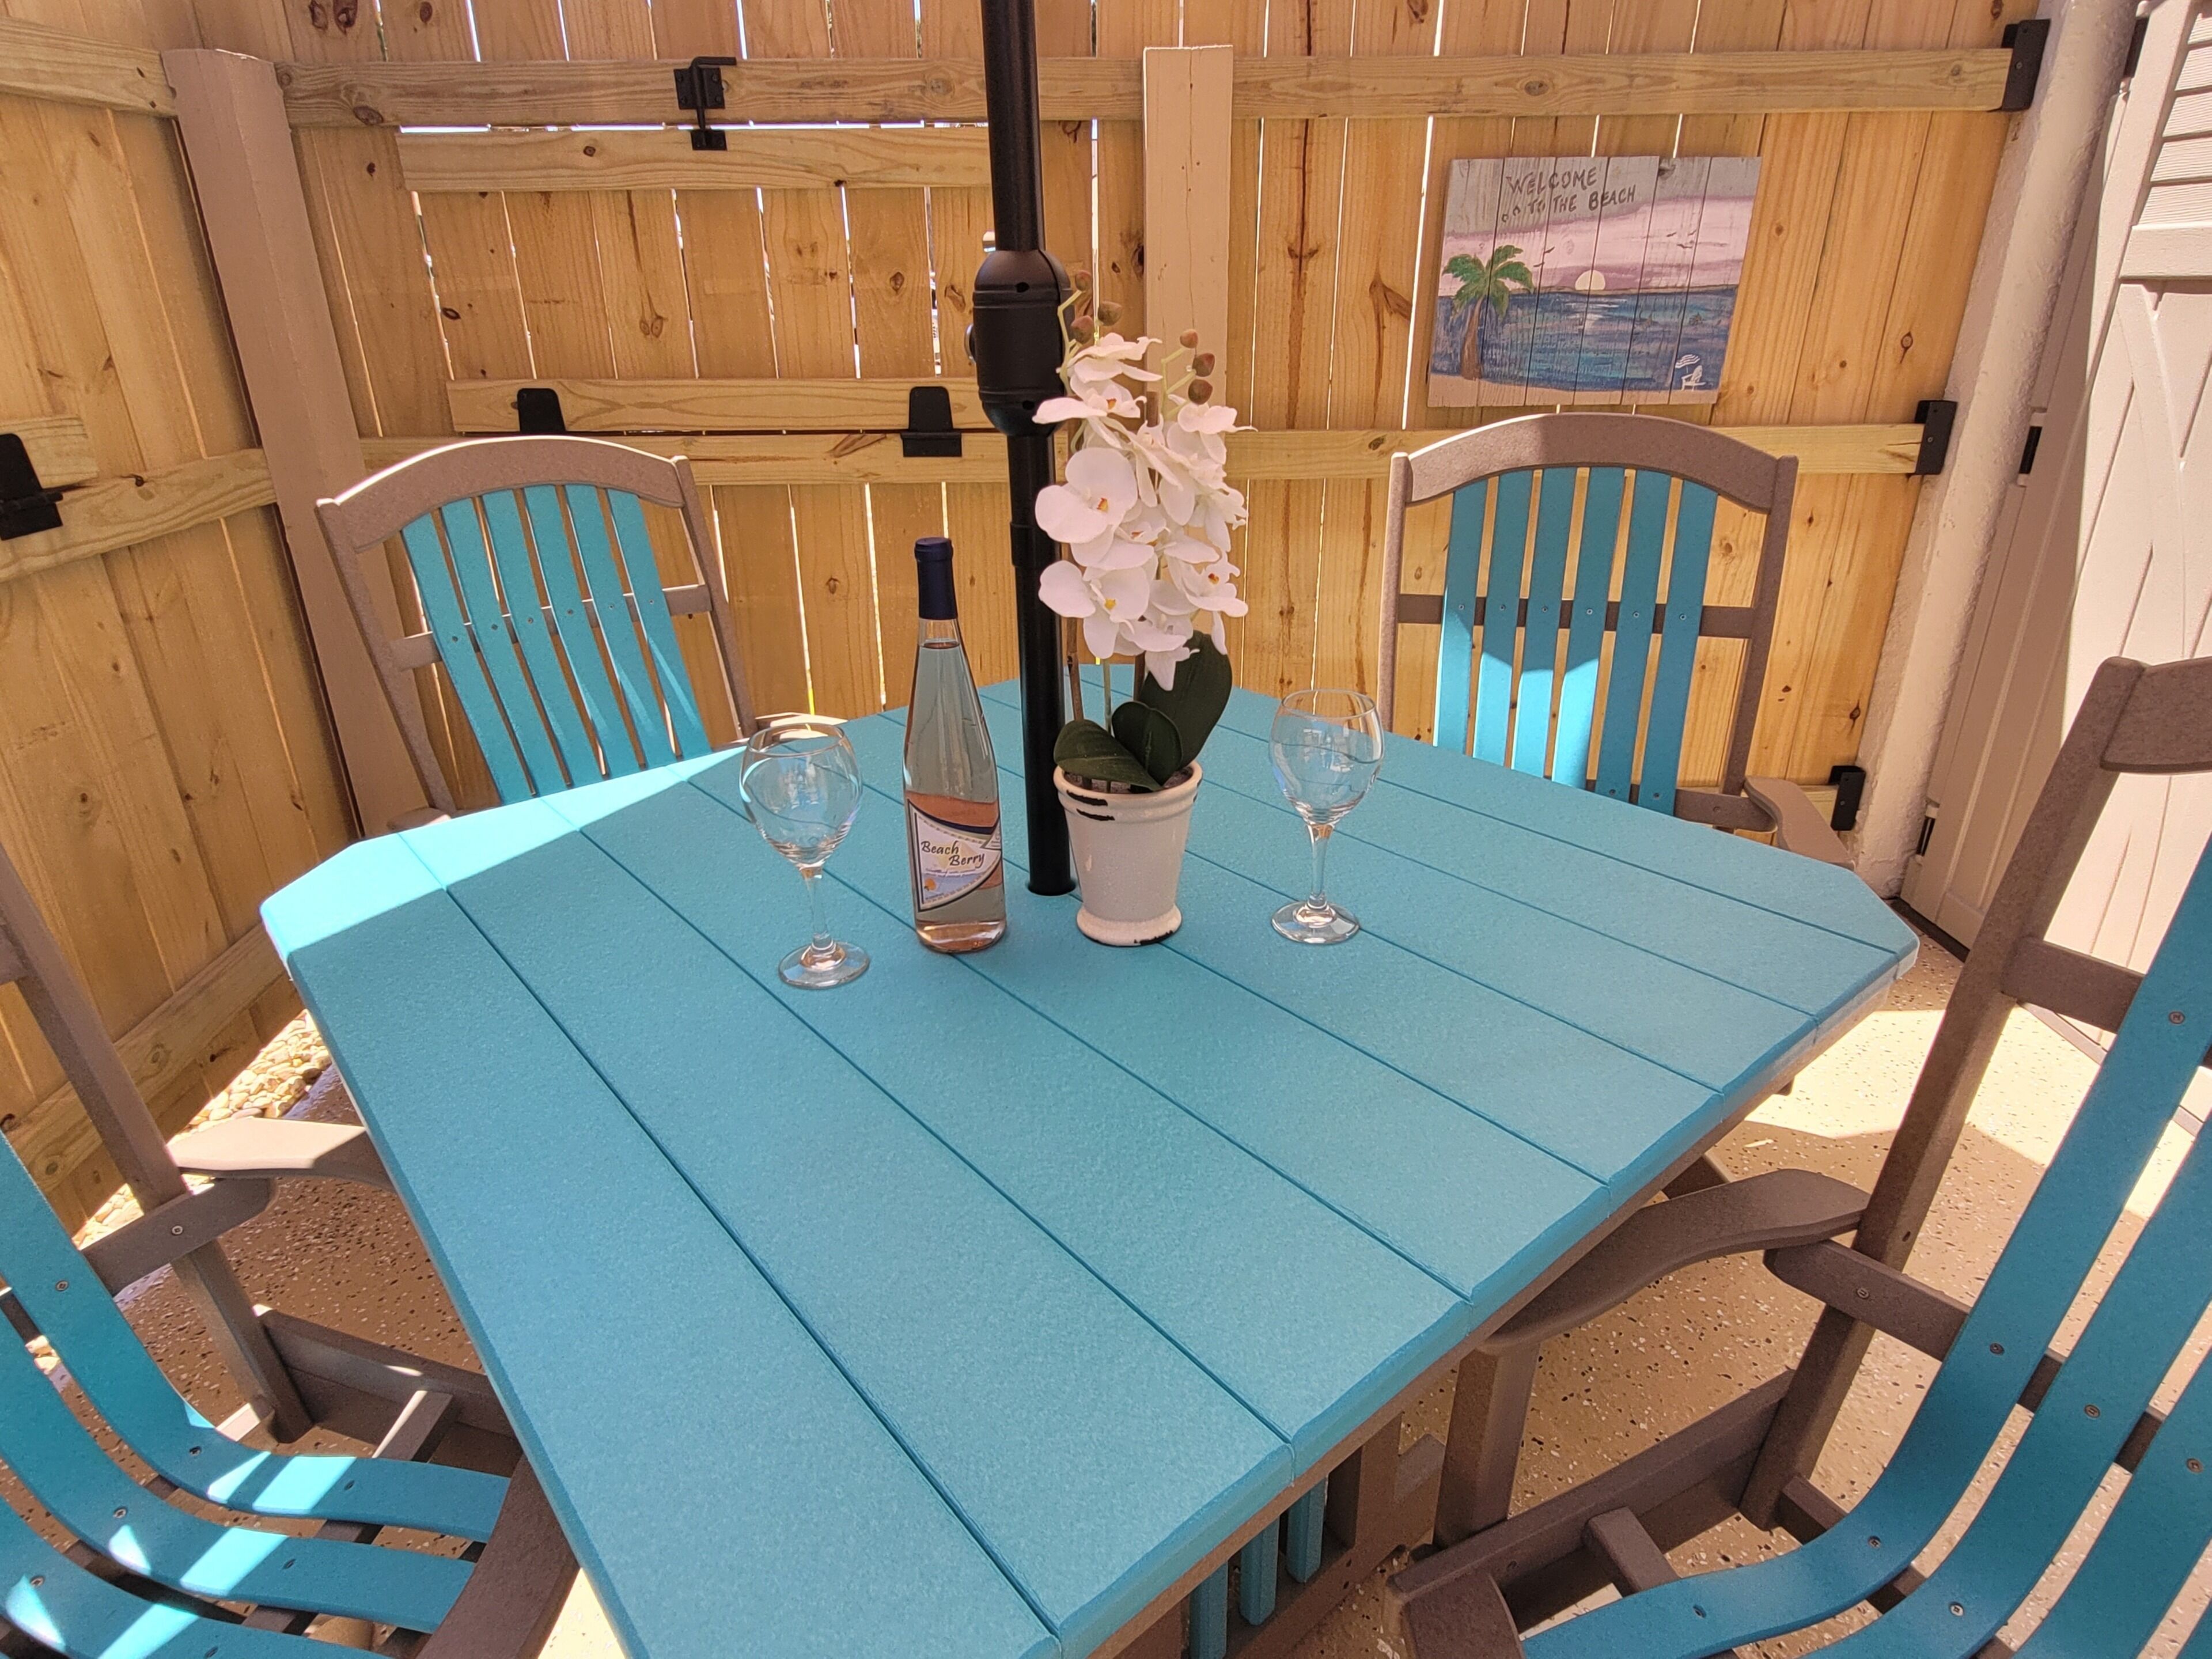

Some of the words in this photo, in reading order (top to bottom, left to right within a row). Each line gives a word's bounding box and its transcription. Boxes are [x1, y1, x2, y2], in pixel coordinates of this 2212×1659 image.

[1506, 167, 1597, 195] WELCOME
[1528, 198, 1546, 214] TO
[1552, 194, 1577, 213] THE
[1588, 185, 1636, 211] BEACH
[921, 840, 959, 854] Beach
[949, 854, 984, 869] Berry
